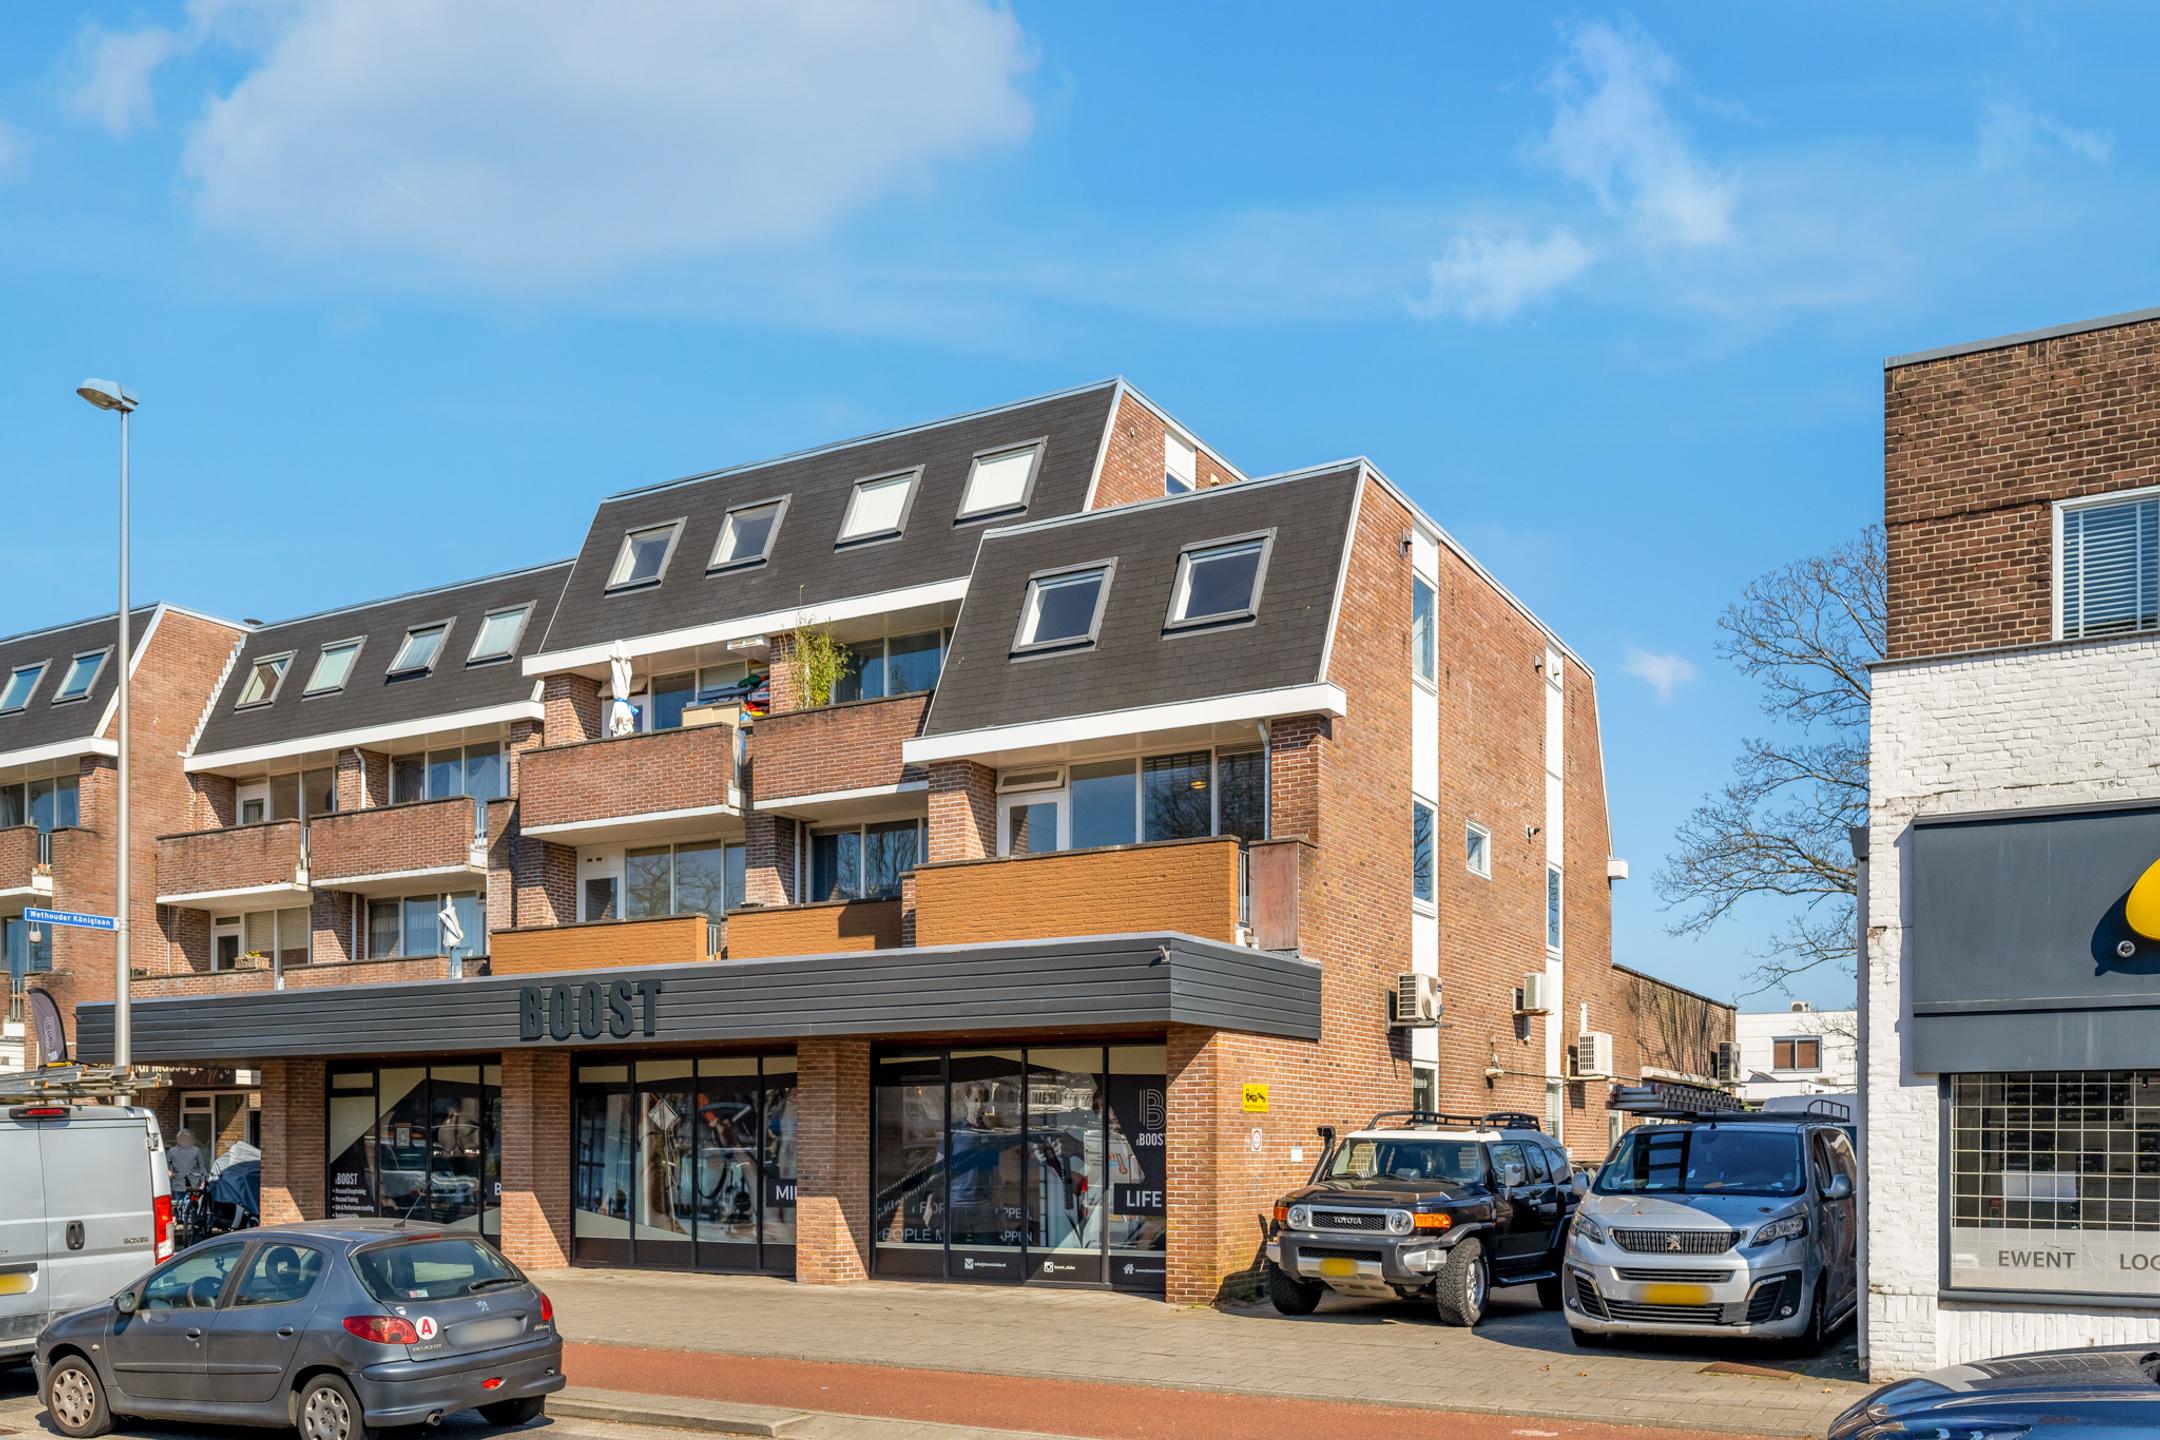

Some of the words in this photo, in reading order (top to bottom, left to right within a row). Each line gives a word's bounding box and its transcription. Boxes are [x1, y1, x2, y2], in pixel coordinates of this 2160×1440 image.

[30, 910, 71, 921] Wethouder
[519, 979, 662, 1042] BOOST
[337, 1173, 358, 1185] BOOST
[1126, 1190, 1163, 1208] LIFE
[1334, 1216, 1361, 1225] TOYOTA
[1999, 1251, 2075, 1268] EWENT
[421, 1319, 433, 1335] A
